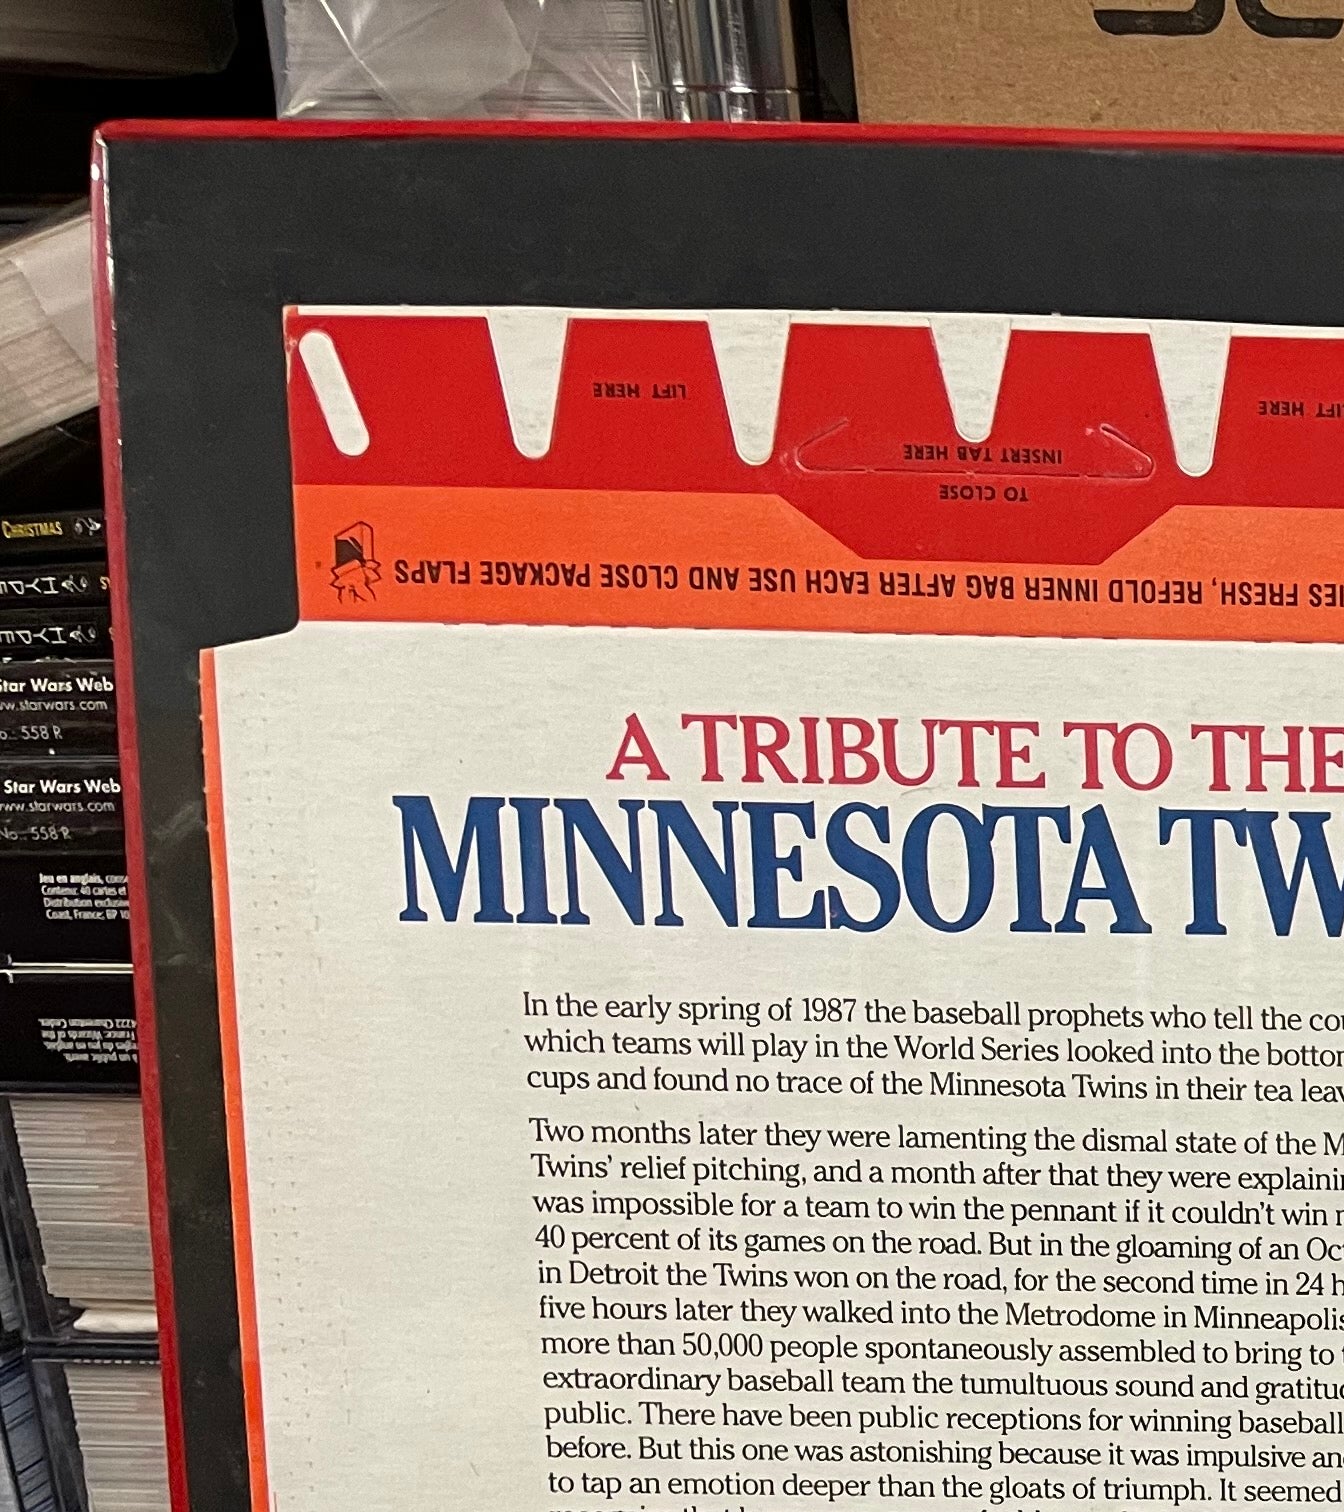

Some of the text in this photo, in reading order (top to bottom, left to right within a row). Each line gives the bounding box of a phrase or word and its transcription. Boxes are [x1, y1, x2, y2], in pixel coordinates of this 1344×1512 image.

[592, 382, 688, 399] LIFT HERE
[903, 445, 1063, 465] INSERT TAB HERE
[395, 560, 470, 584] FLAPS
[480, 562, 591, 587] PACKAGE
[600, 564, 679, 589] CLOSE
[689, 567, 739, 590] AND
[748, 568, 795, 592] USE
[805, 570, 868, 594] EACH
[880, 573, 955, 598] AFTER
[965, 575, 1014, 600] BAG
[1028, 577, 1097, 602] INNER
[1113, 579, 1196, 604] REFOLD
[1212, 576, 1298, 606] FRESH,
[30, 679, 73, 692] Wars
[76, 678, 114, 692] Web
[606, 713, 670, 782] A
[681, 712, 1045, 790] TRIBUTE
[1063, 722, 1173, 792] TO
[4, 778, 121, 793] Star Wars Web
[392, 795, 1151, 936] MINNESOTA
[524, 992, 548, 1016] In
[556, 992, 598, 1017] the
[606, 994, 672, 1026] early
[679, 994, 760, 1027] spring
[768, 996, 792, 1021] of
[802, 998, 856, 1022] 1987
[864, 998, 906, 1023] the
[912, 1000, 1020, 1025] baseball
[1028, 1003, 1144, 1034] prophets
[1150, 1004, 1206, 1028] who
[1214, 1006, 1252, 1029] tell
[1261, 1006, 1302, 1030] the
